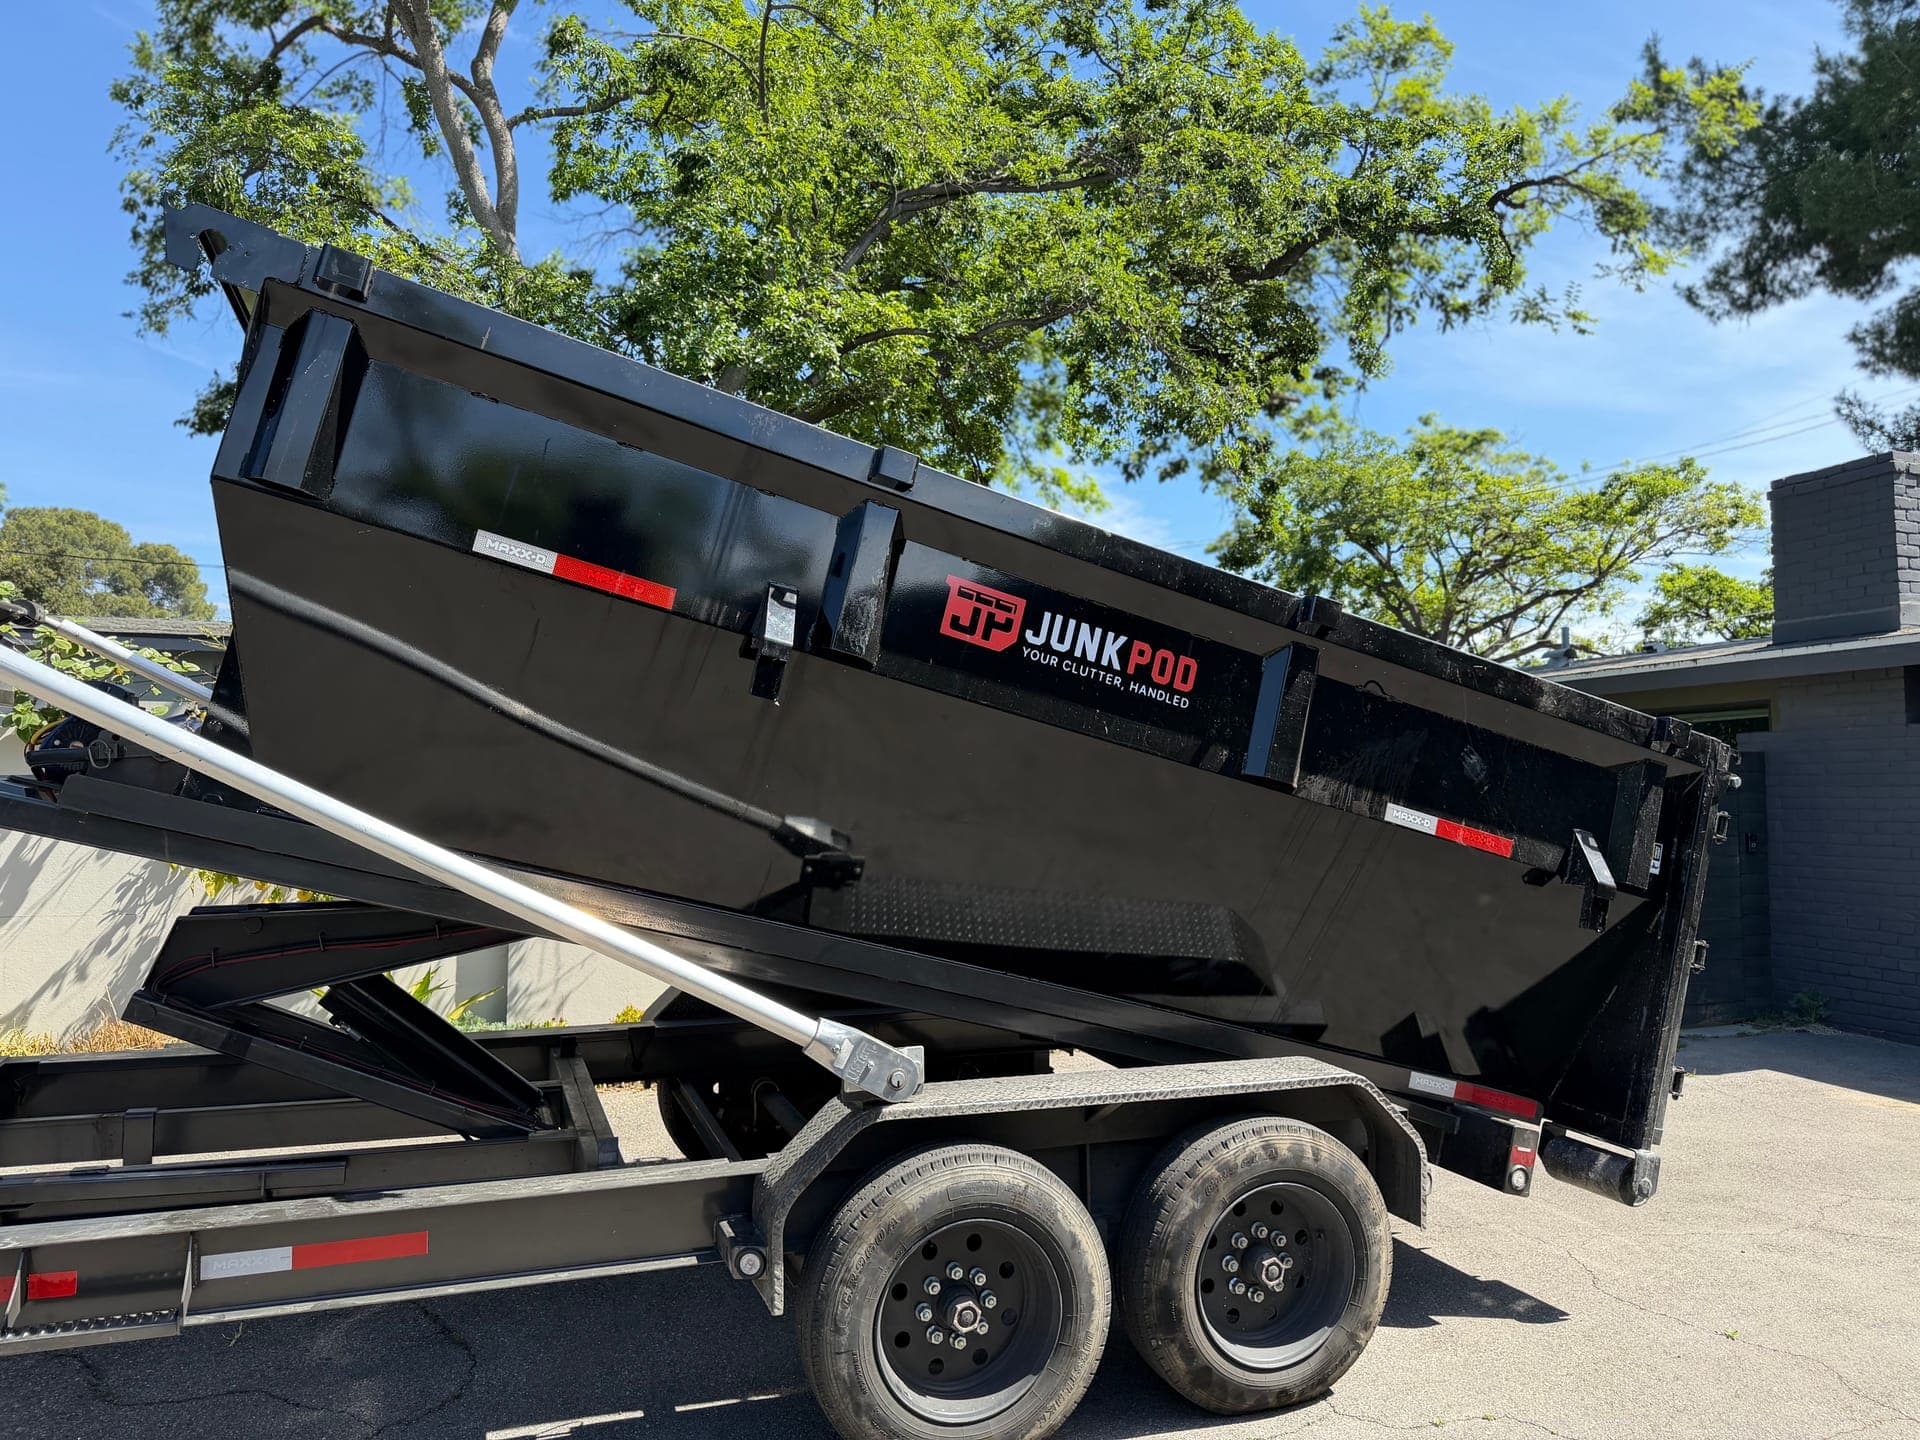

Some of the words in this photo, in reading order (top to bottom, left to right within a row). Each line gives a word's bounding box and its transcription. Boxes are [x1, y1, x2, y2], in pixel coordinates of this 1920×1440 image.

[485, 538, 547, 564] MAXX-D
[1022, 645, 1059, 668] YOUR
[1062, 659, 1124, 691] CLUTTER,
[1129, 681, 1189, 709] HANDLED
